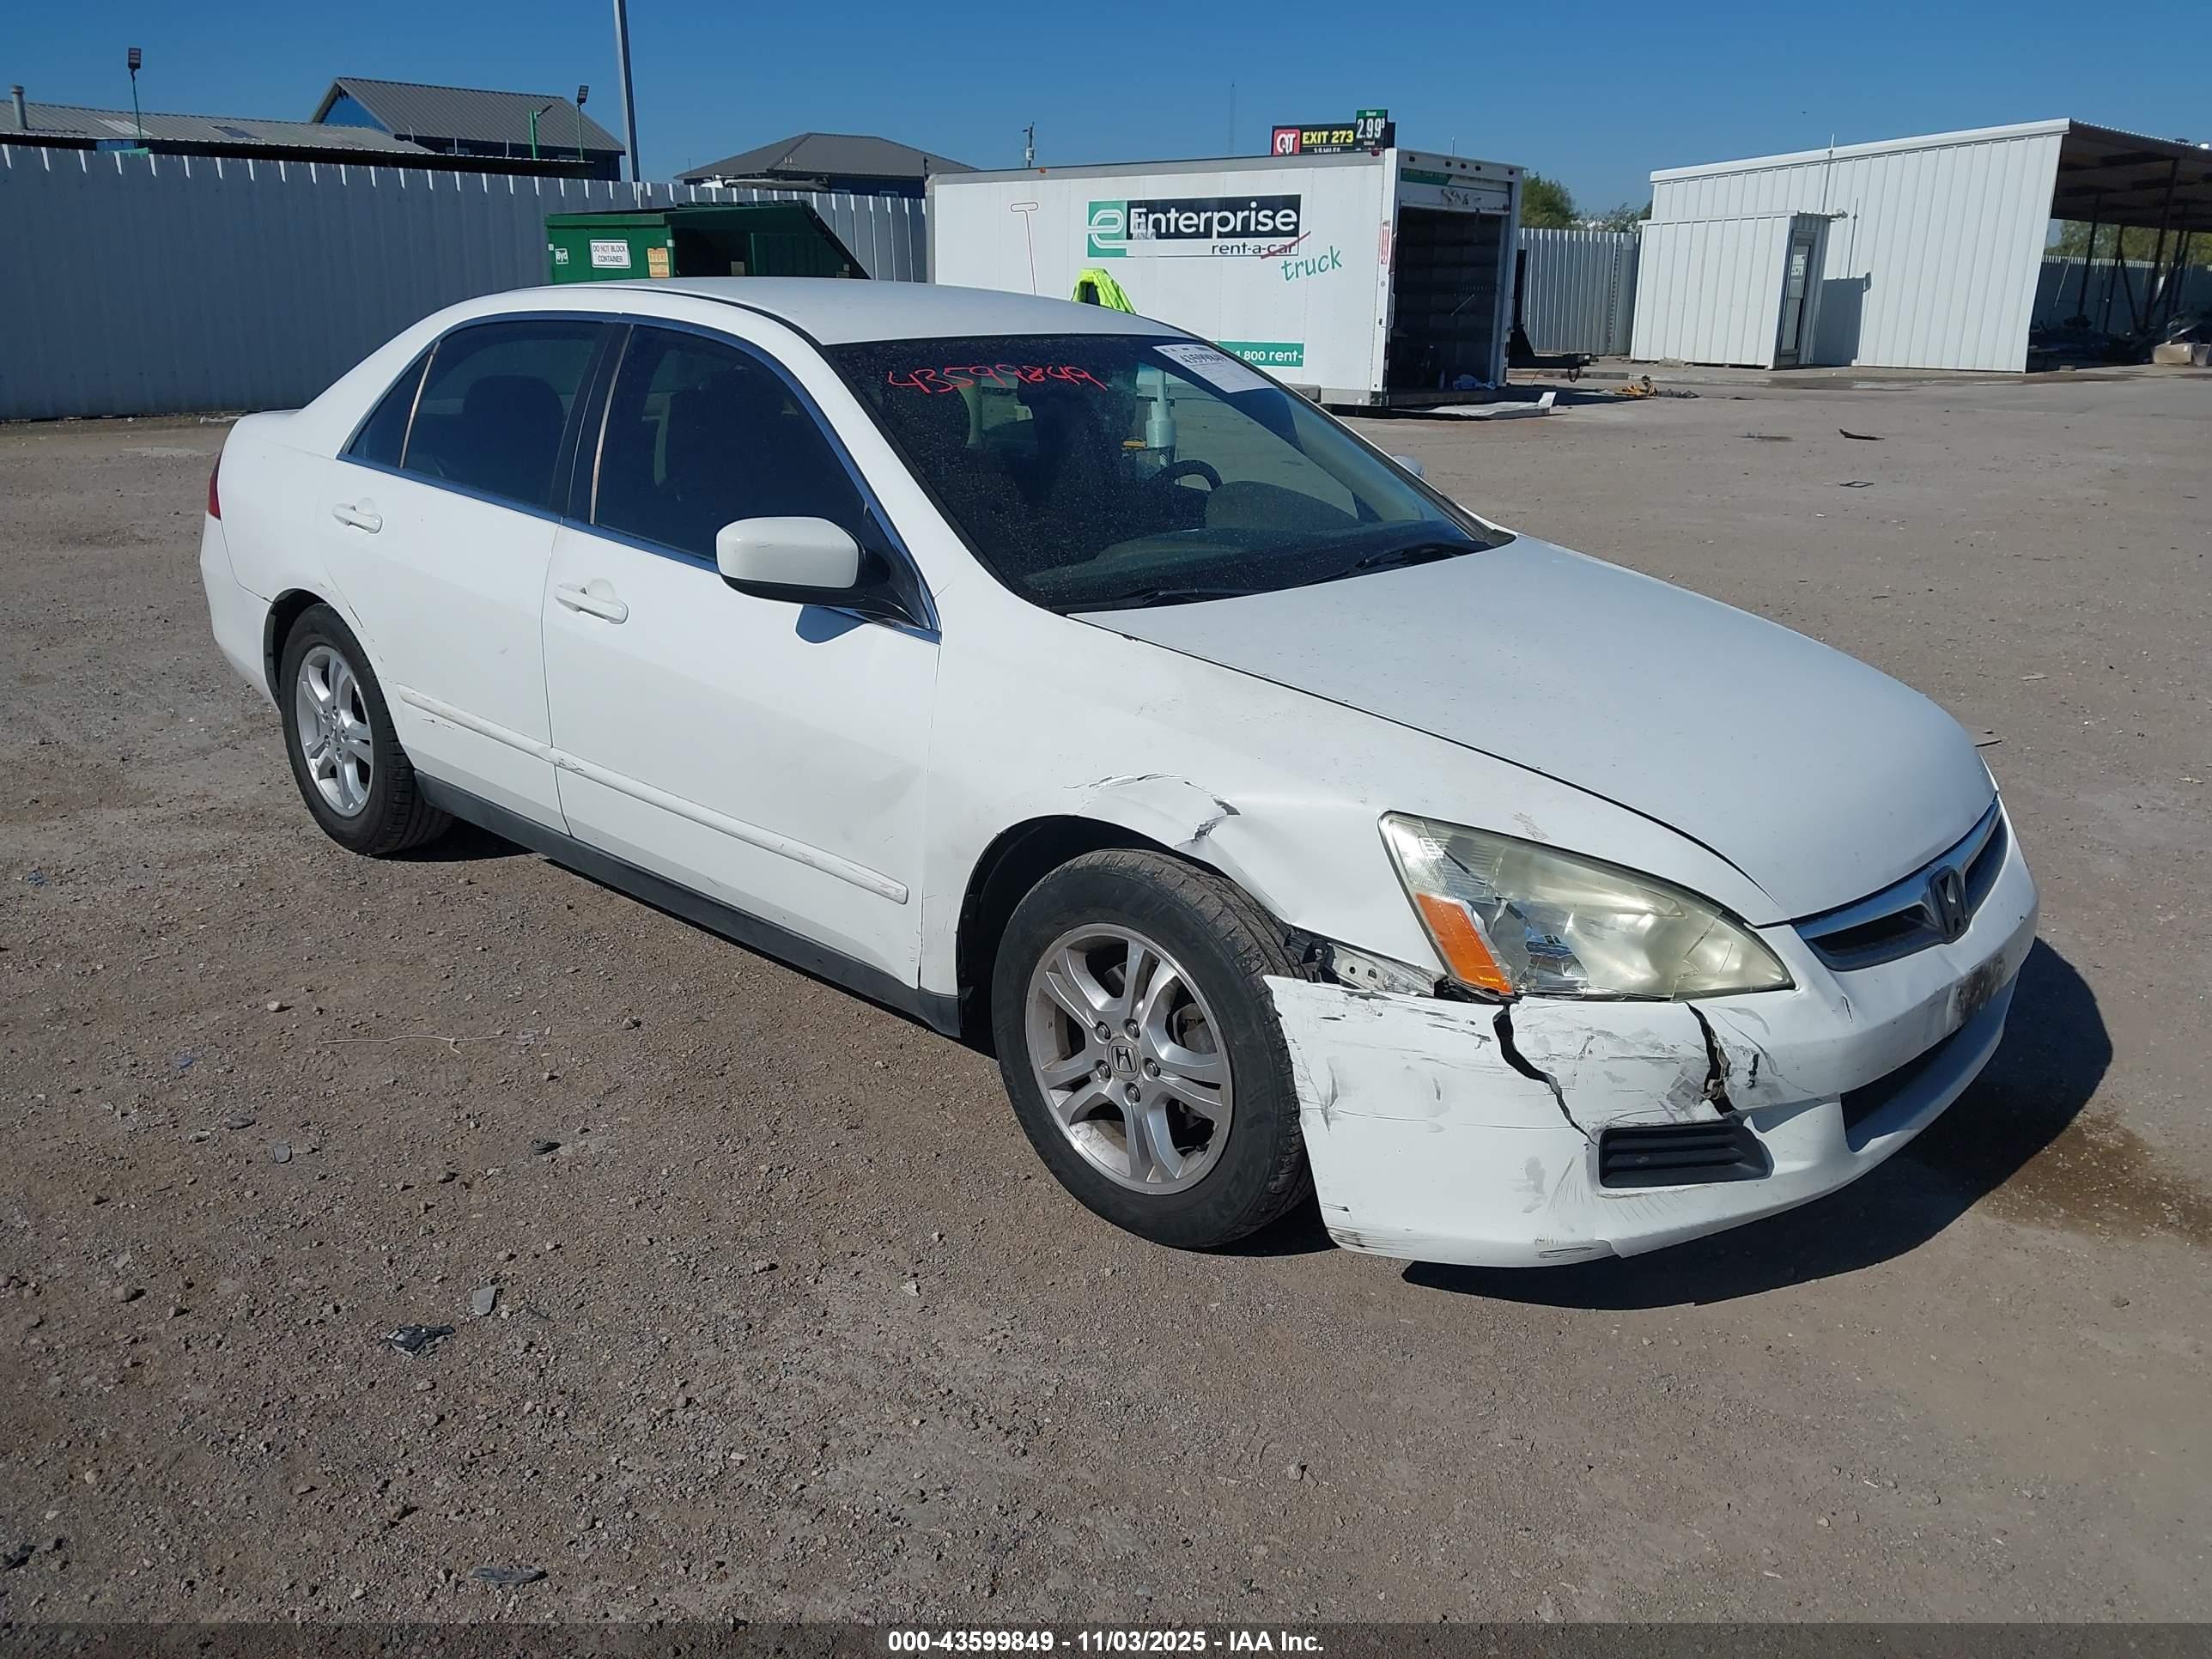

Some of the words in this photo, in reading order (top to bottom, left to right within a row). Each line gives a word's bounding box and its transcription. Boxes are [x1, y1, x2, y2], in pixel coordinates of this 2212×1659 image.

[1276, 133, 1296, 154] QT
[1302, 131, 1329, 144] EXIT
[1331, 130, 1354, 143] 273
[1129, 201, 1297, 240] Enterprise
[1212, 242, 1296, 255] rent-a-car
[1280, 245, 1342, 282] truck
[1243, 350, 1266, 362] 800
[1268, 349, 1303, 362] rent-
[887, 363, 1108, 394] 43599849
